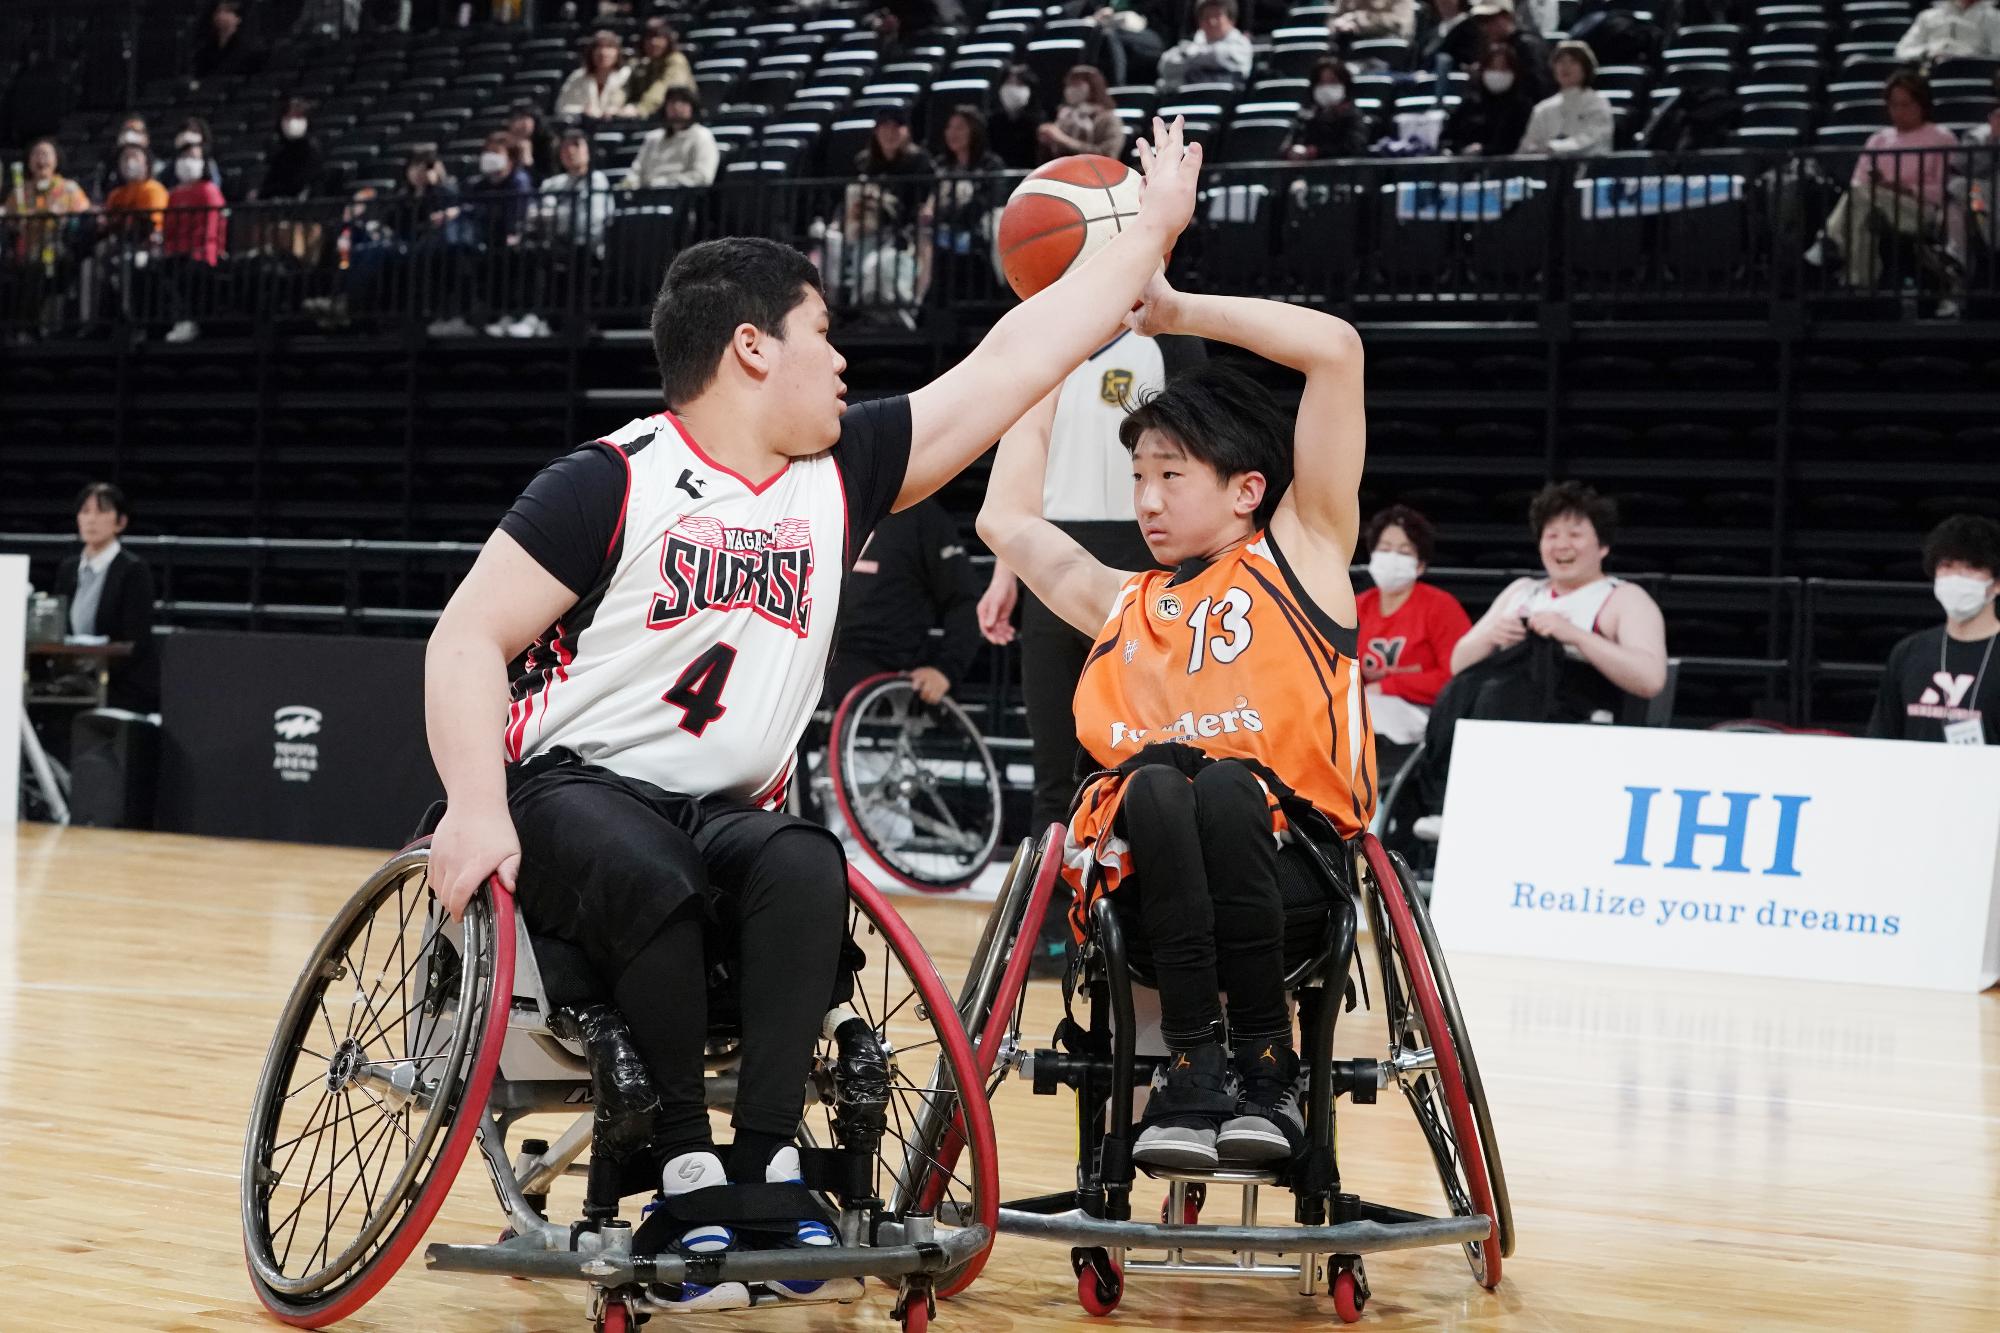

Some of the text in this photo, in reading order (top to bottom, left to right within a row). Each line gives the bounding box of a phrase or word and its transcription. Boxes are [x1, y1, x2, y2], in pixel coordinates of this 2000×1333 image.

[1188, 586, 1253, 675] 13
[660, 641, 737, 738] 4
[1613, 786, 1812, 877] IHI
[1510, 882, 1901, 936] Realize your dreams
